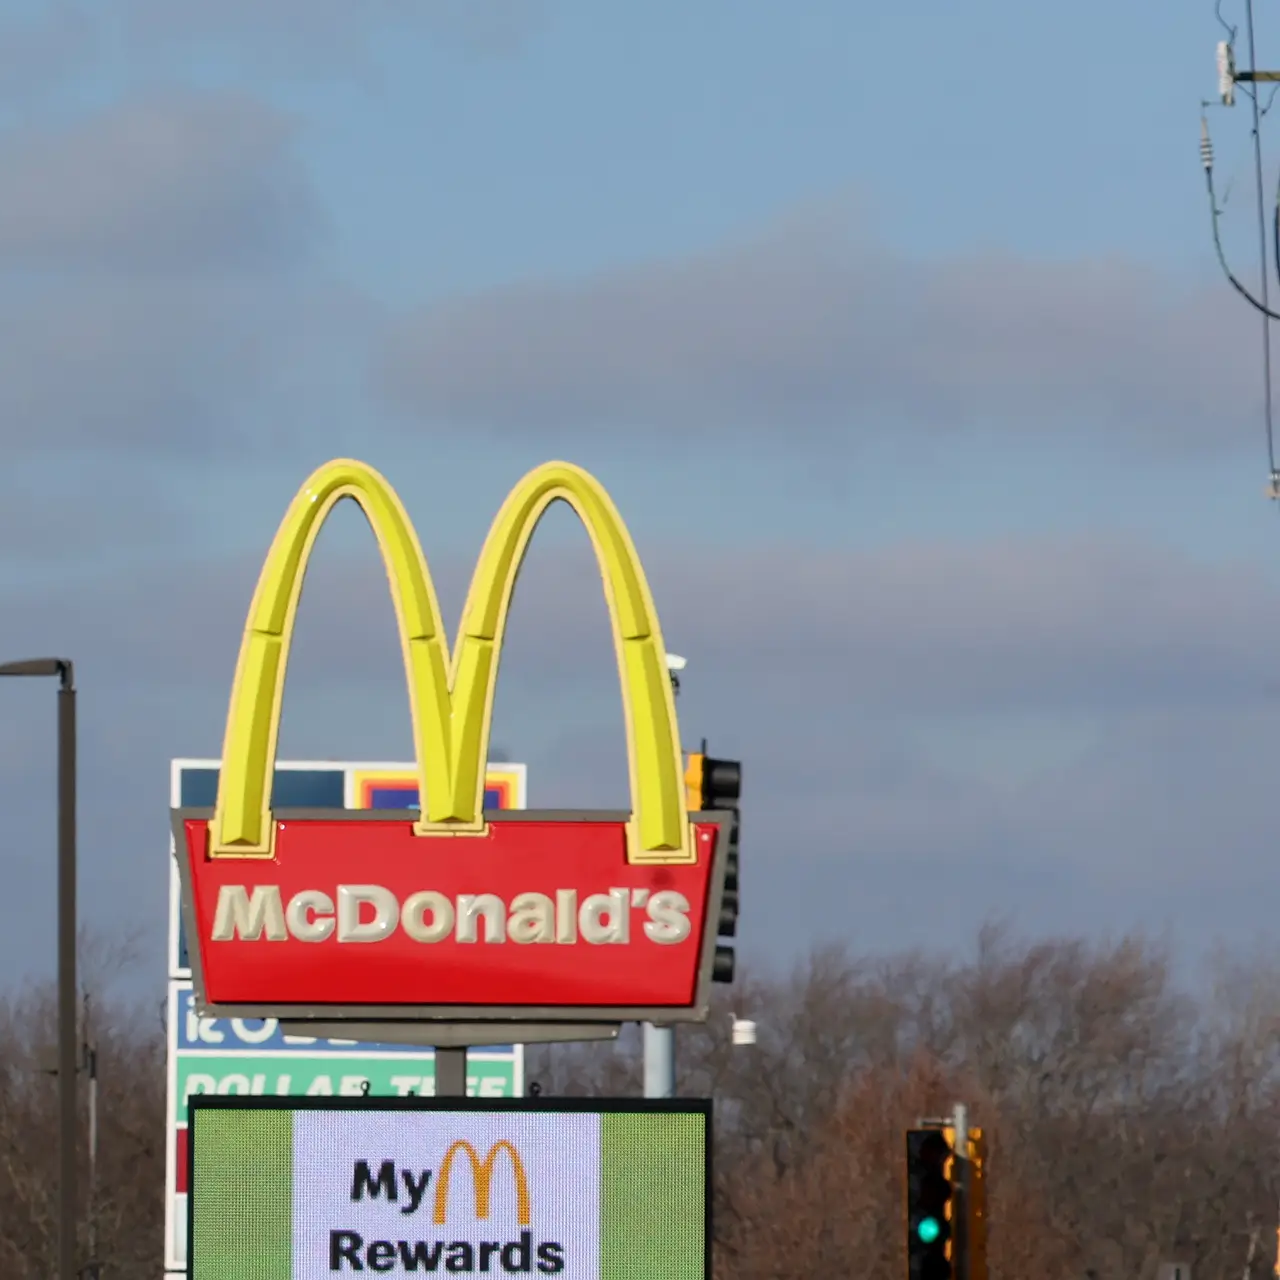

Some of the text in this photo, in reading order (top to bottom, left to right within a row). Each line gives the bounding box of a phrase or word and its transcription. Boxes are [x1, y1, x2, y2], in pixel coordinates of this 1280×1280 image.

[211, 884, 691, 945] McDonald's
[351, 1158, 432, 1215] My
[329, 1228, 565, 1274] Rewards
